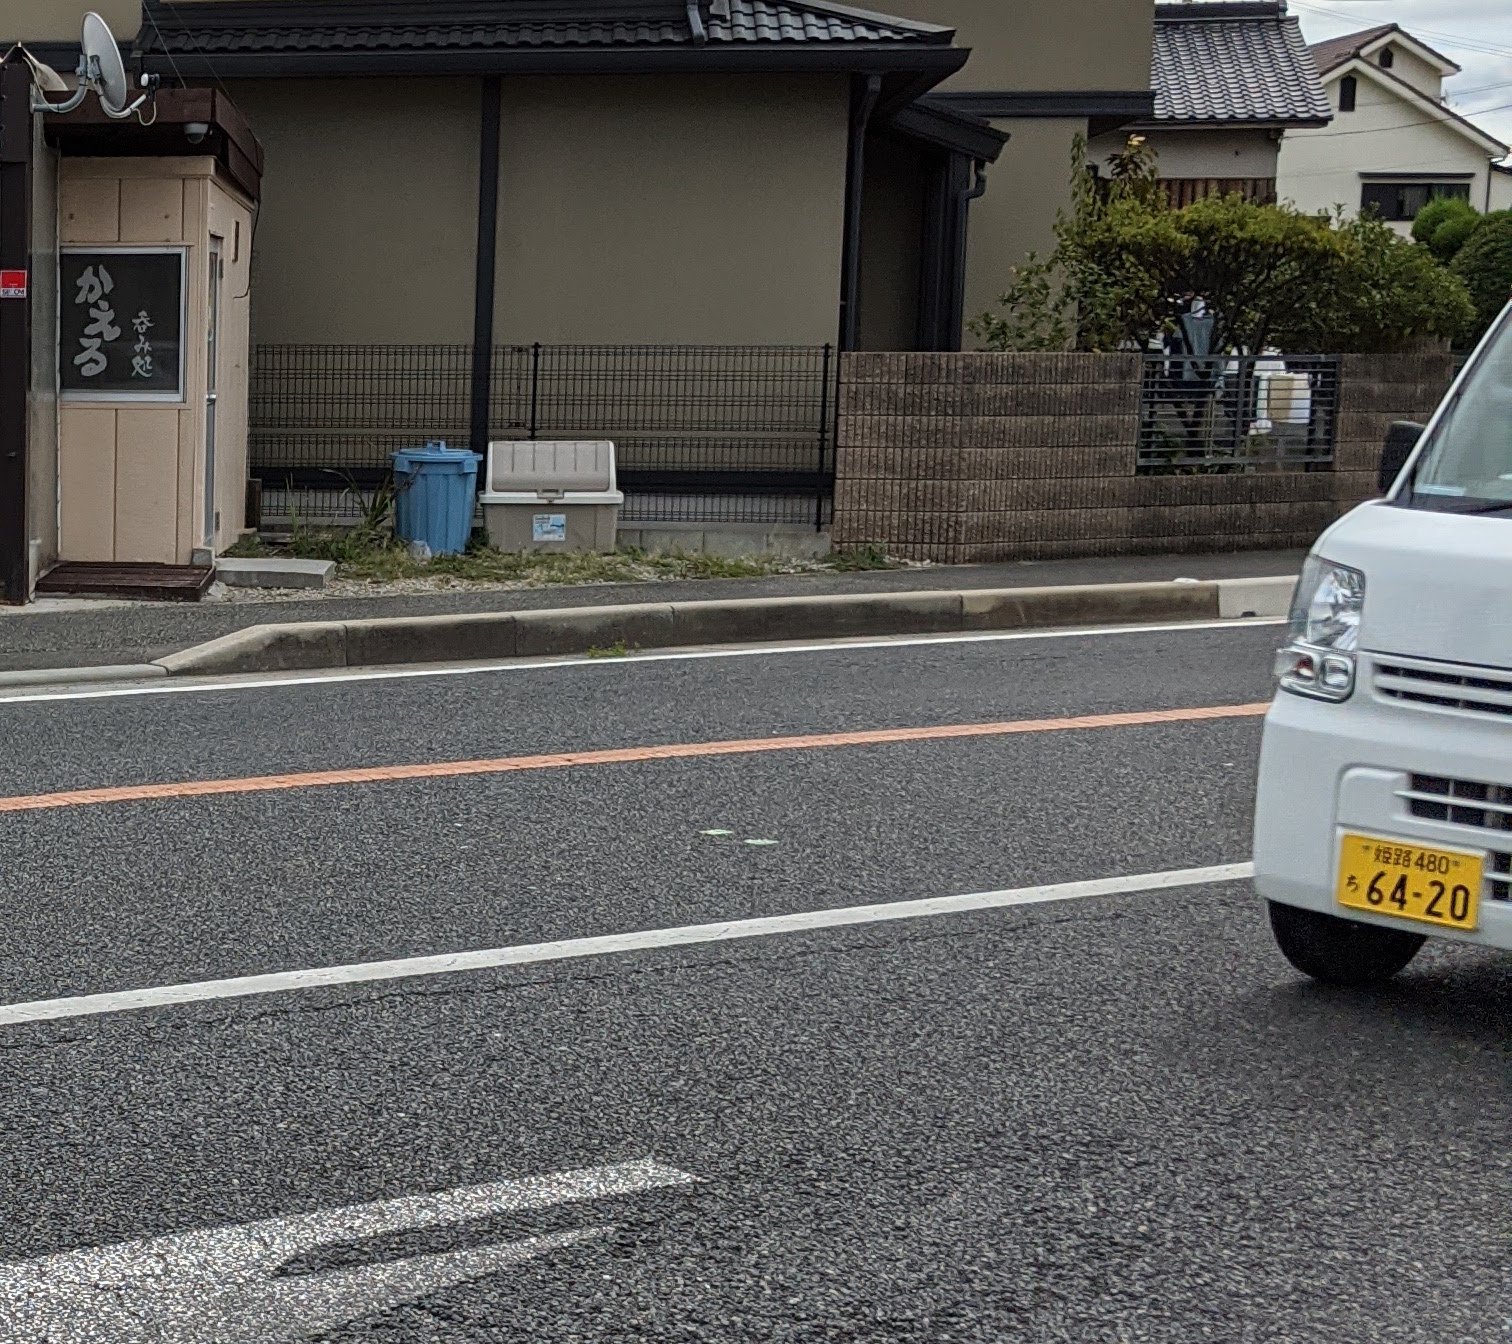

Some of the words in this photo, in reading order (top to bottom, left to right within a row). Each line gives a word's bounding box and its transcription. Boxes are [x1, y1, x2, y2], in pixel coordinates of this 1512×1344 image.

[74, 264, 121, 377] かえる
[131, 309, 156, 377] 呑み処
[1414, 851, 1450, 875] 480
[1366, 870, 1471, 922] 64-20
